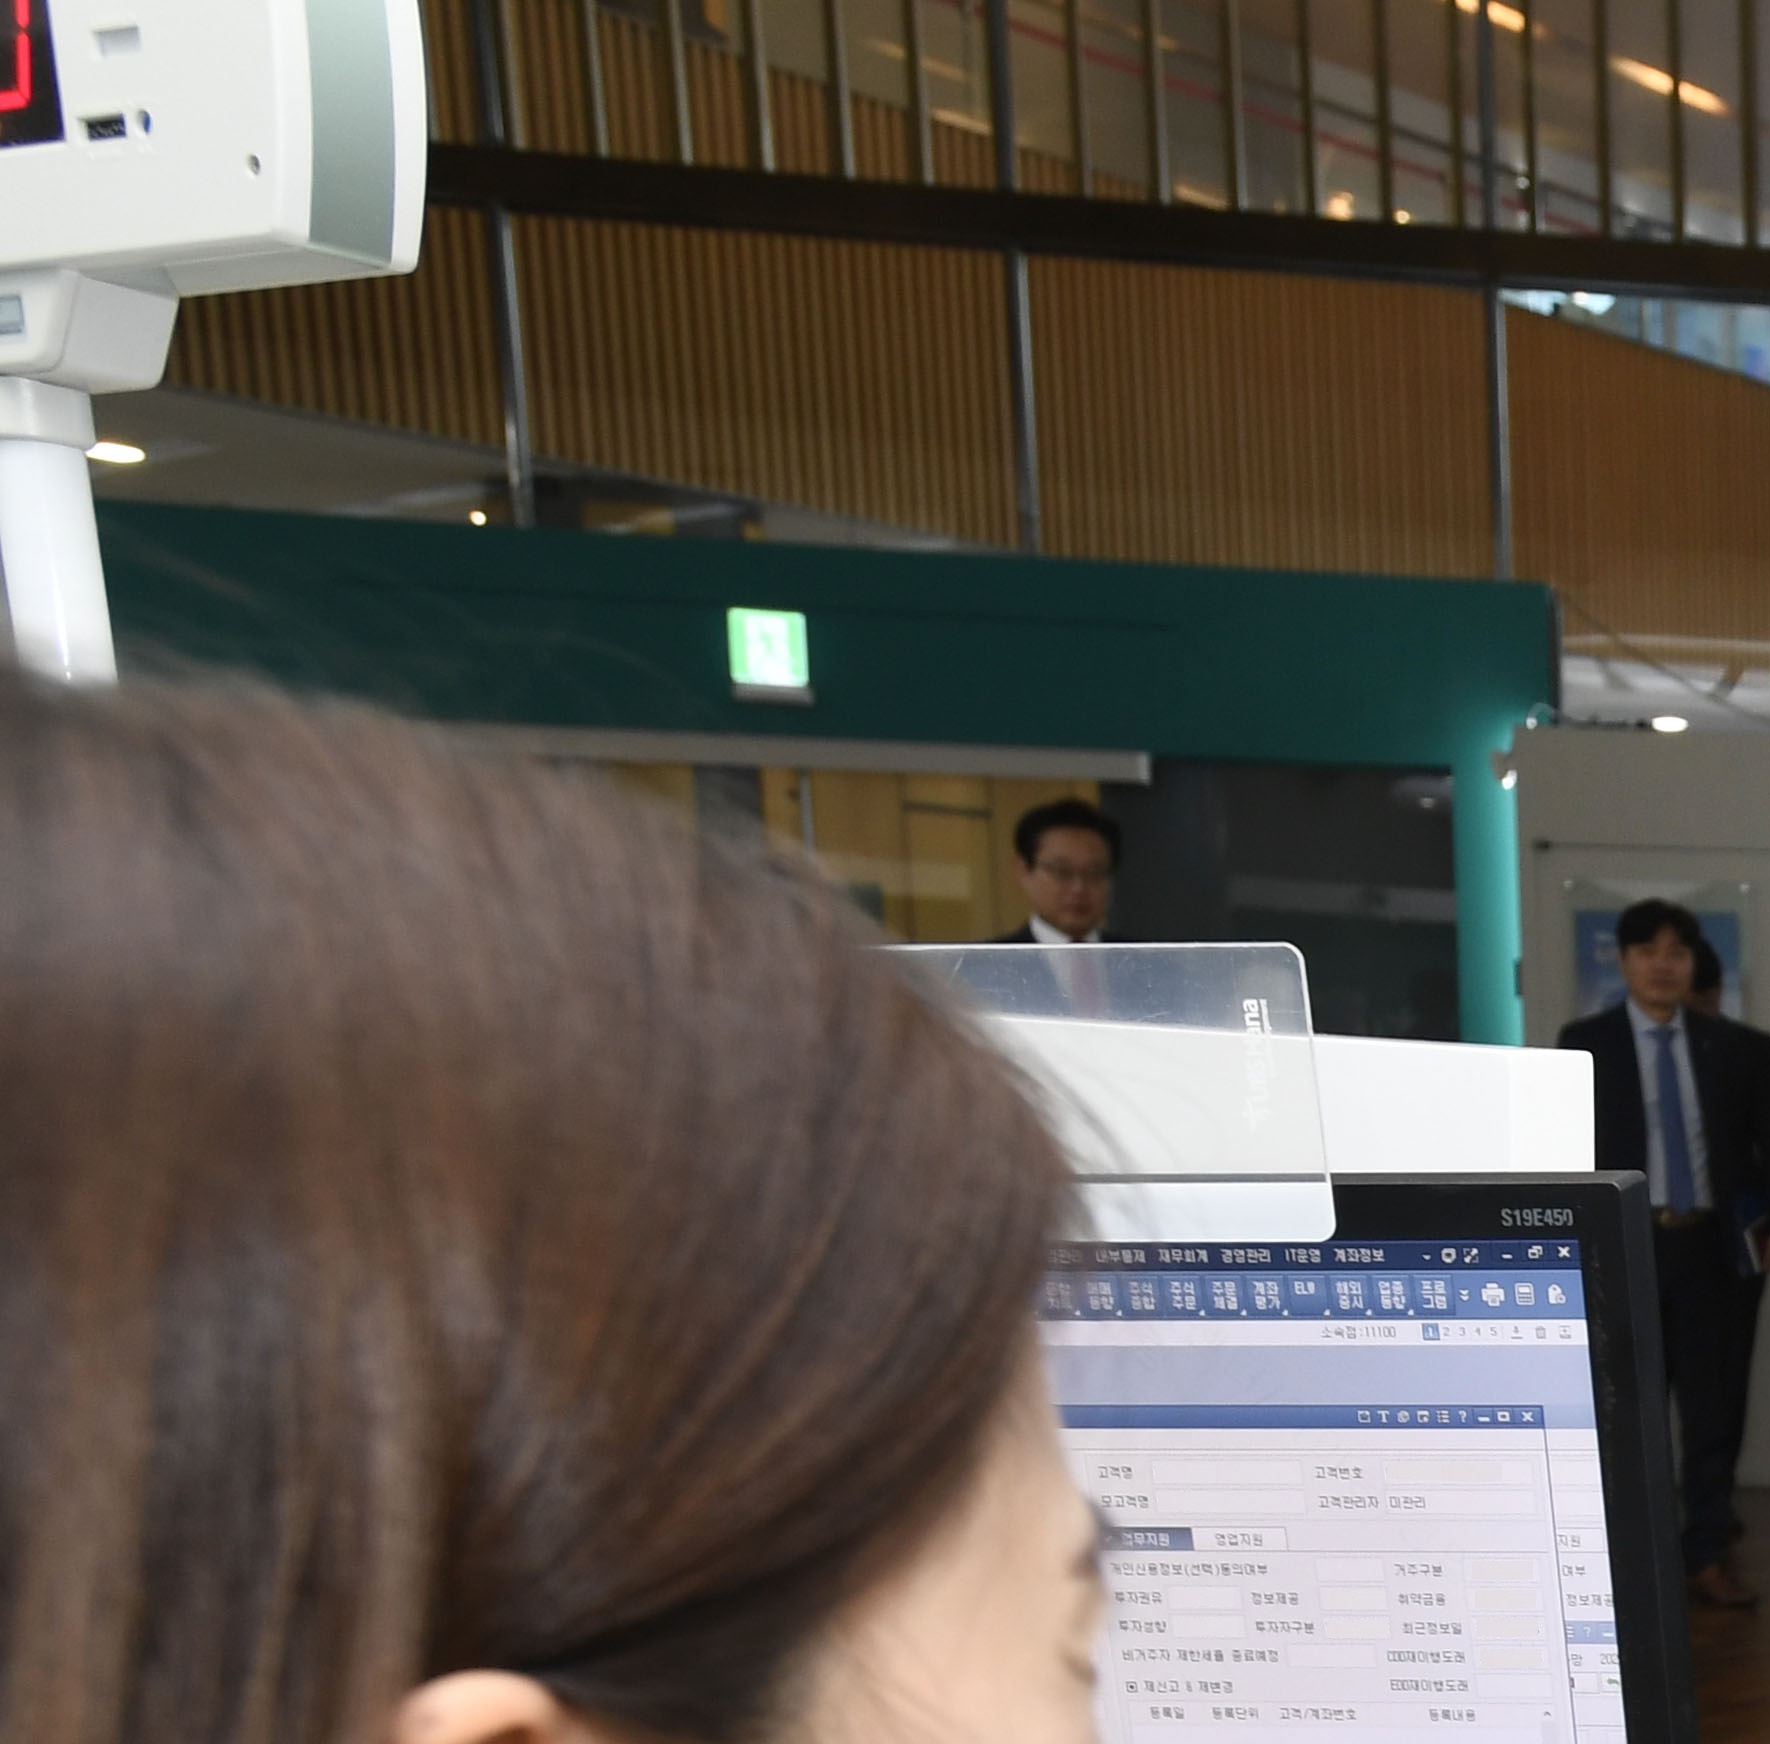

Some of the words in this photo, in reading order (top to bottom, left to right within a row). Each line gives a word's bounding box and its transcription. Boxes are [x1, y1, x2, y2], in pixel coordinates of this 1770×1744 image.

[1501, 1208, 1574, 1227] S19E450
[1098, 1466, 1133, 1480] 고객명
[1314, 1466, 1364, 1480] 고객번호
[1214, 1532, 1264, 1546] 영업지원
[1394, 1563, 1443, 1577] 거주구분
[1251, 1591, 1300, 1605] 정보제공
